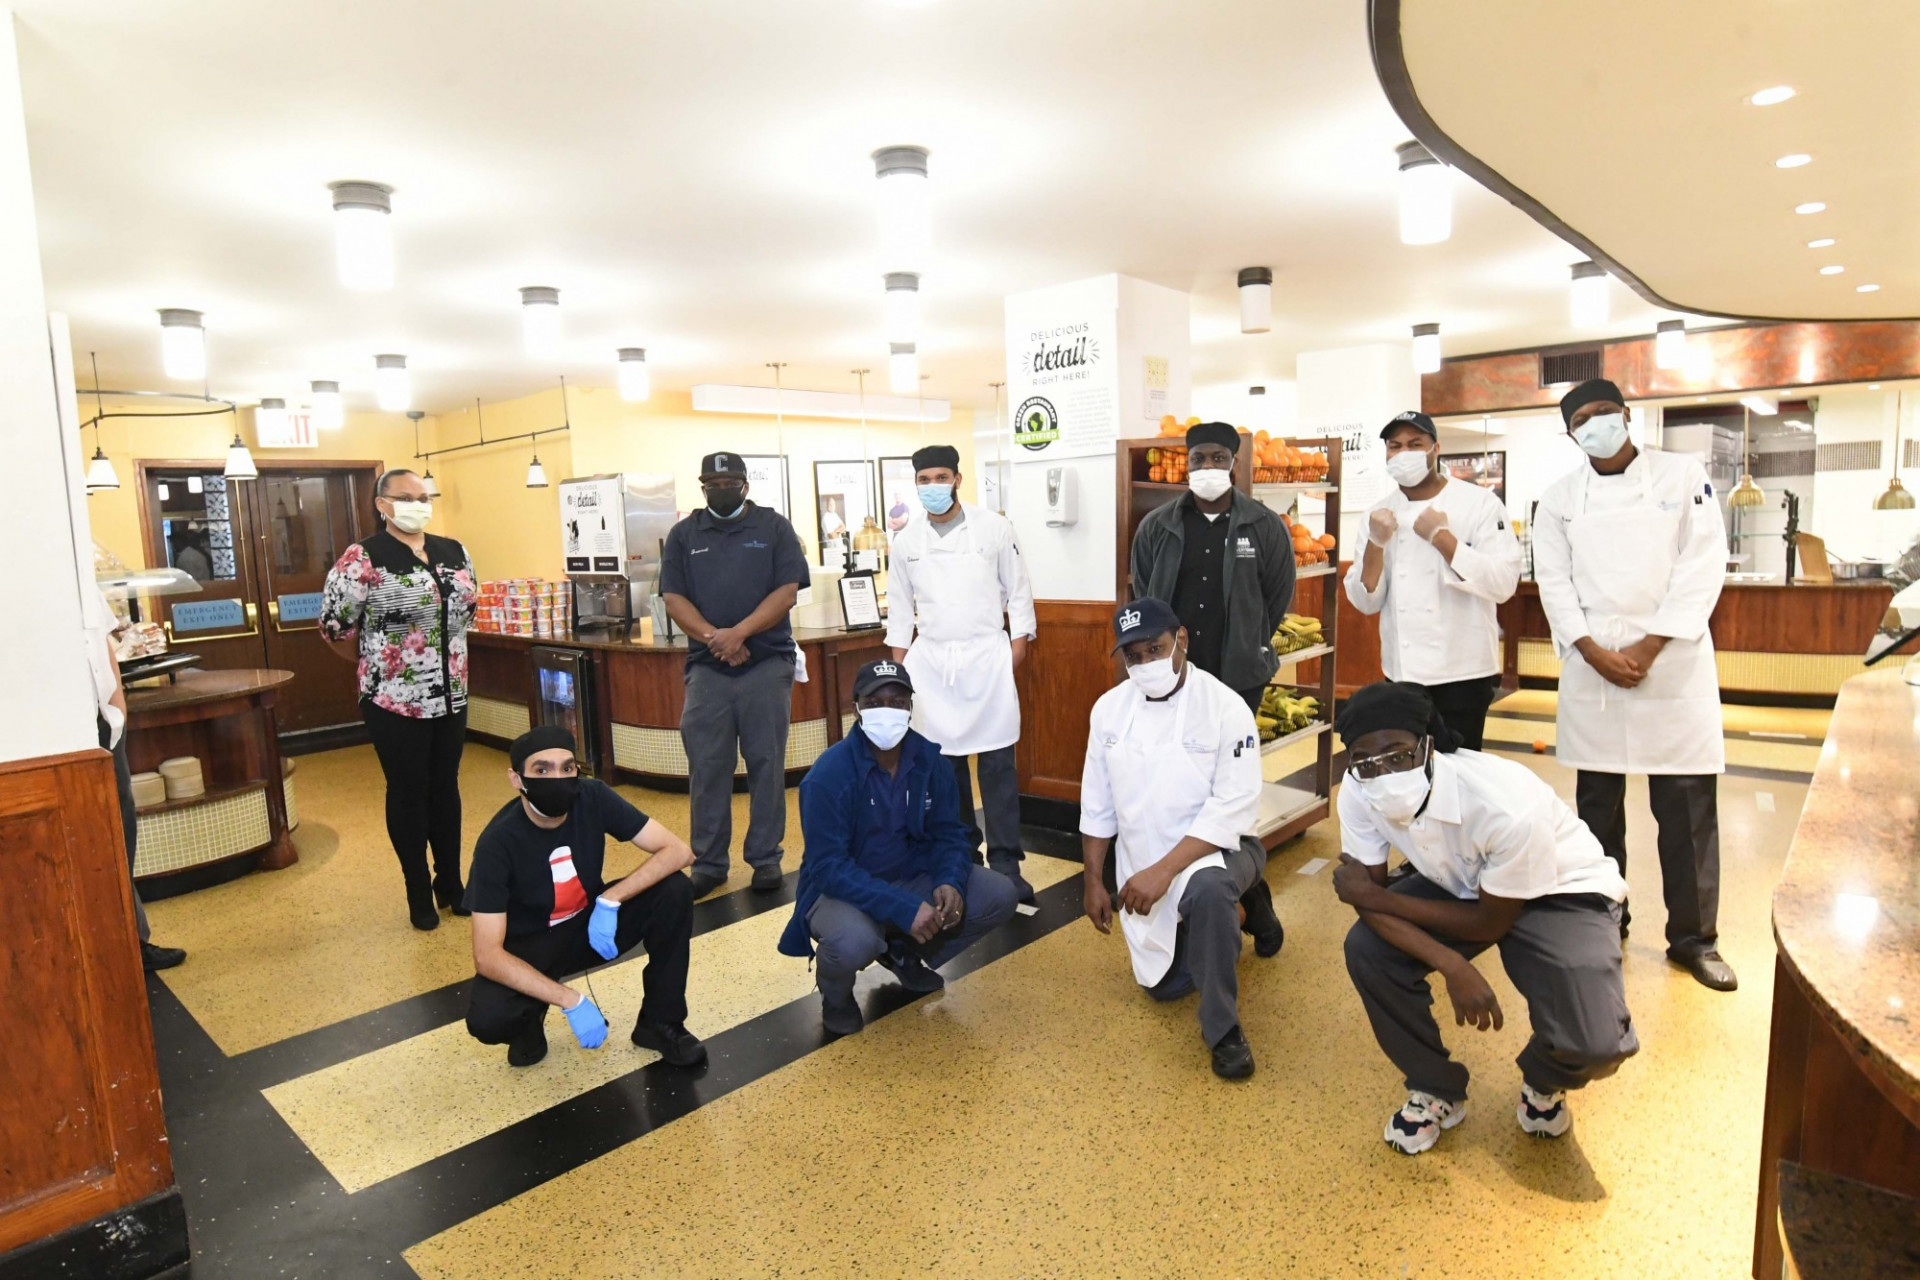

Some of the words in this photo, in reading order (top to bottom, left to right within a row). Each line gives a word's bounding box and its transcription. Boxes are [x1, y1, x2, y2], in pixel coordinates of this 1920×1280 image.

[1030, 322, 1089, 342] DELICIOUS
[1033, 336, 1087, 373] detail
[1032, 375, 1059, 386] RIGHT
[1062, 370, 1090, 381] HERE!
[1025, 397, 1057, 423] RESTAURANT
[1316, 423, 1364, 434] DELICIOUS
[1016, 430, 1057, 443] CERTIFIED
[714, 454, 729, 473] C
[1444, 458, 1470, 467] MEET
[577, 491, 598, 508] detail
[178, 604, 238, 615] EMERGENCY
[288, 606, 309, 615] EXIT
[182, 615, 206, 624] EXIT
[209, 612, 236, 622] ONLY
